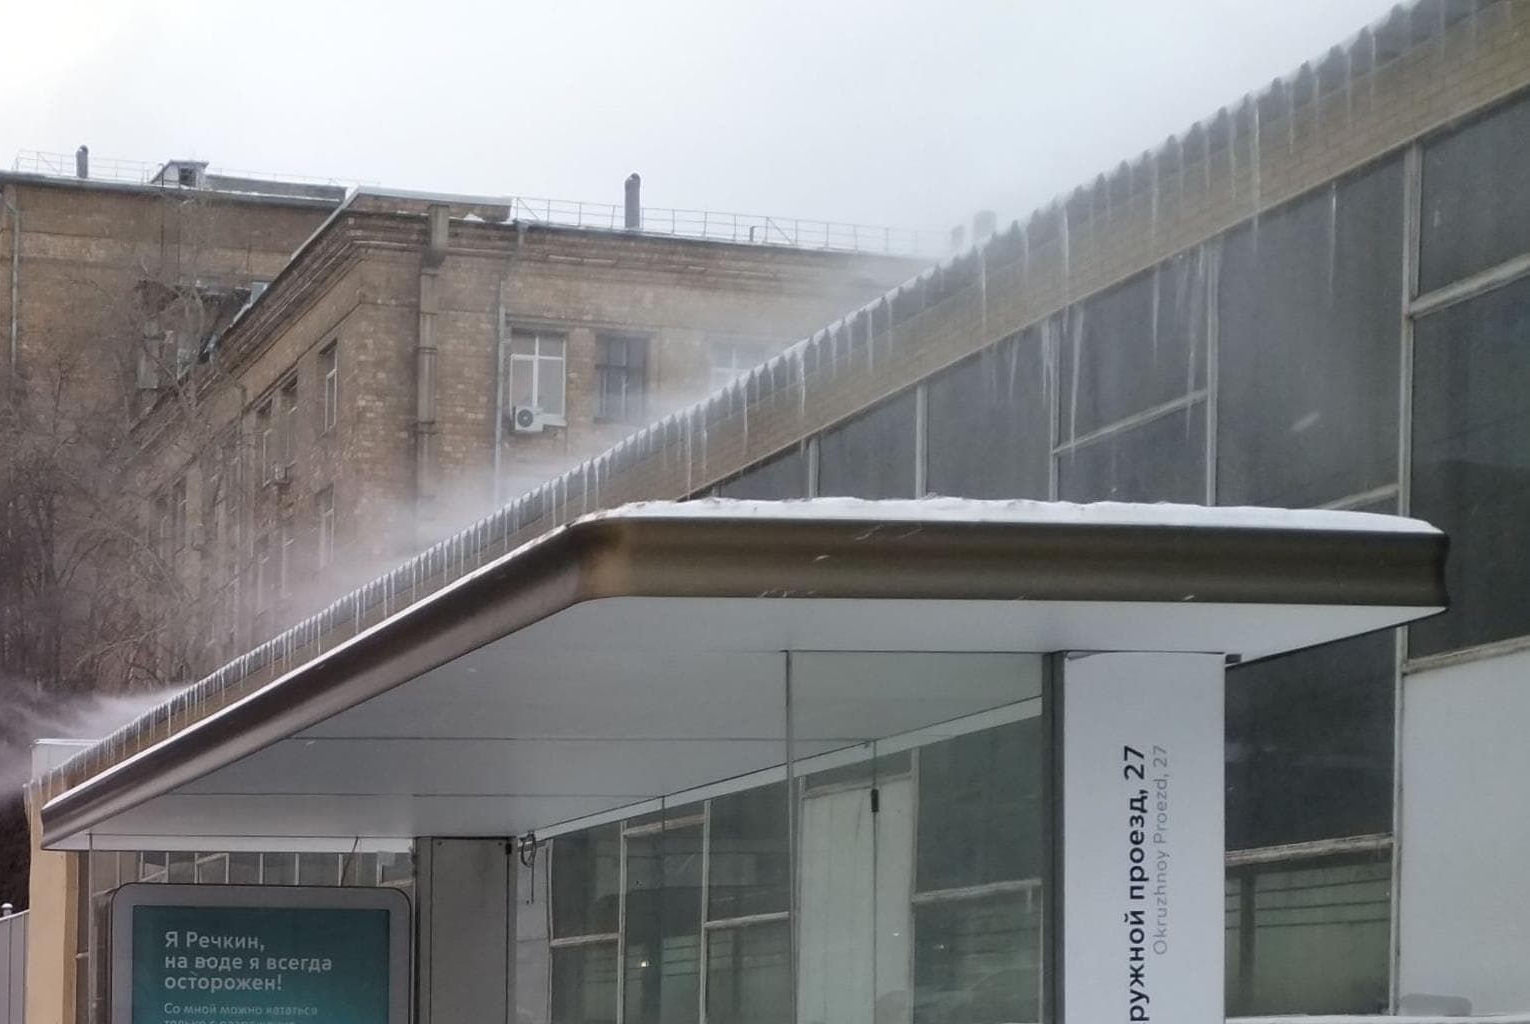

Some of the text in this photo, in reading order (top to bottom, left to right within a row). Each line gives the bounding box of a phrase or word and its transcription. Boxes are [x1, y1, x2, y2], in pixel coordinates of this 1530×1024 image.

[1123, 745, 1145, 780] 27
[1128, 788, 1149, 900] проезд,
[1153, 745, 1170, 956] Okruzhnoy Proezd, 27
[165, 931, 265, 952] Я Речкин,
[165, 956, 332, 973] на воде я всегда
[164, 974, 282, 992] осторожен!
[164, 1002, 318, 1016] Со мной можно кататься
